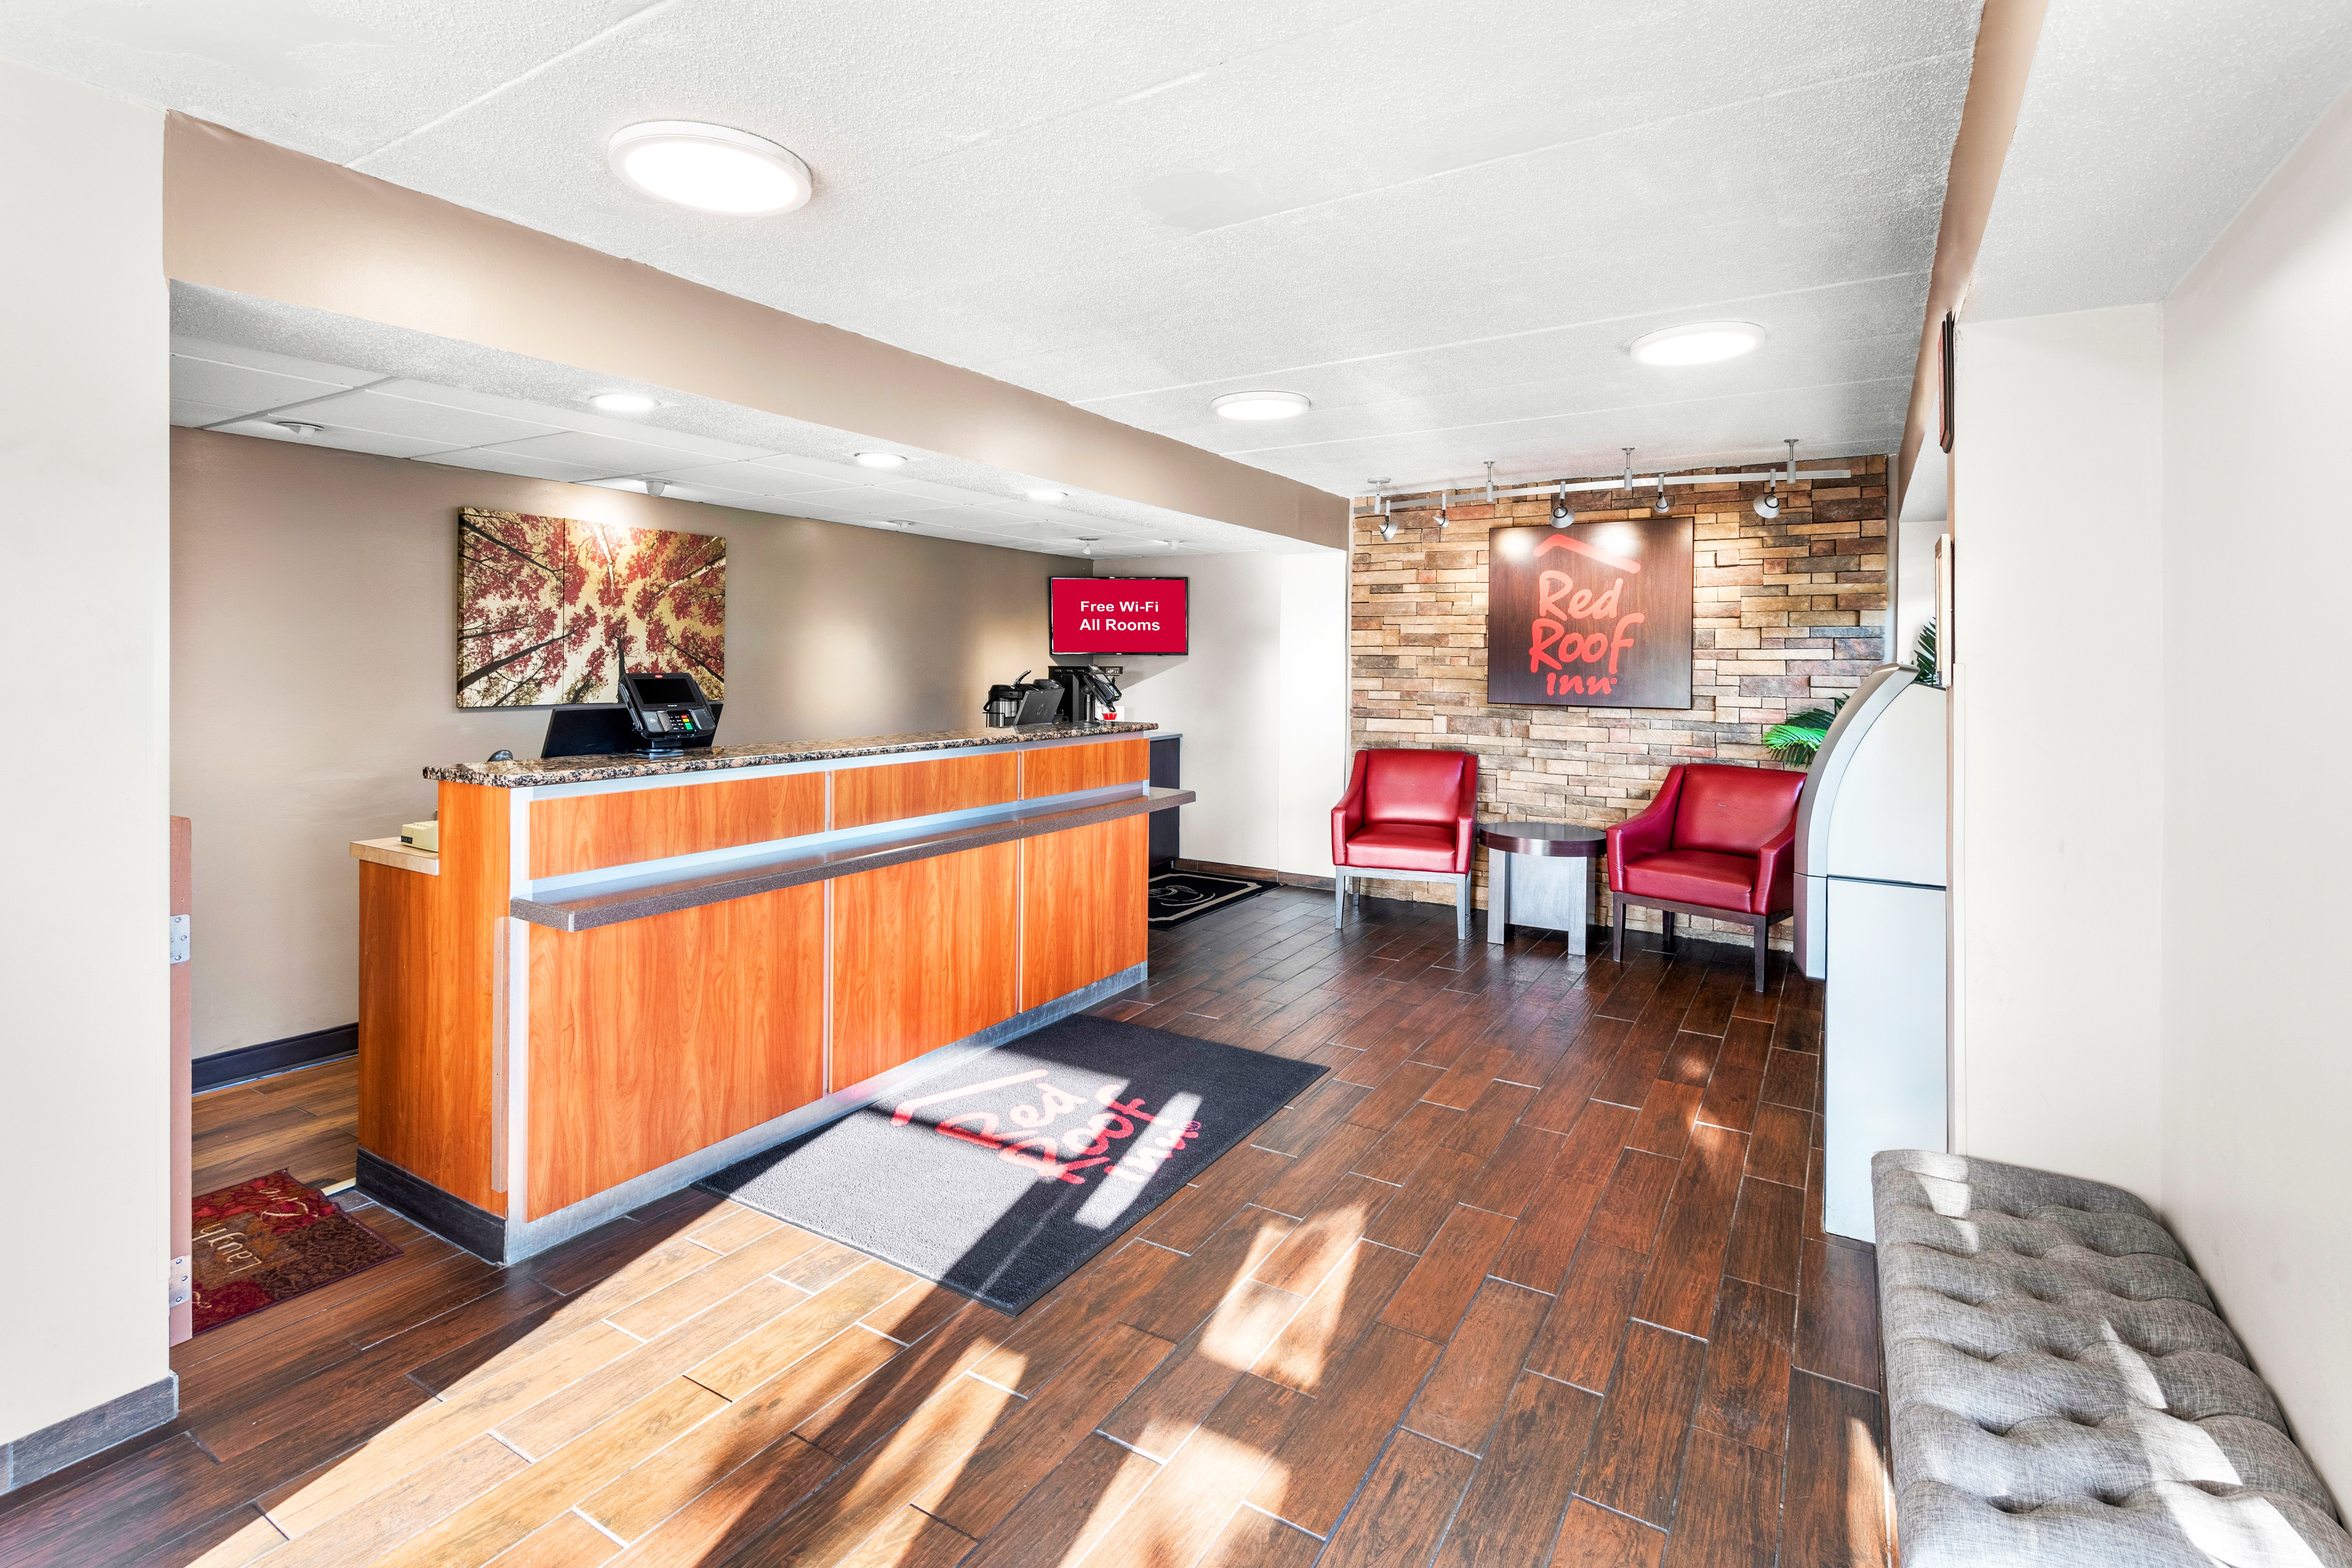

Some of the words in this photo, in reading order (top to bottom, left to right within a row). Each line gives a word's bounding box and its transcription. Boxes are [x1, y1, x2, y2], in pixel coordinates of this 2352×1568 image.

[1080, 601, 1114, 612] Free
[1119, 601, 1159, 612] Wi-Fi
[1539, 570, 1624, 621] Red
[1079, 618, 1100, 631] All
[1106, 619, 1160, 631] Rooms
[1529, 612, 1645, 675] Roof
[936, 1081, 1087, 1149] Red
[999, 1083, 1173, 1185] Roof
[192, 1223, 262, 1274] Laugh
